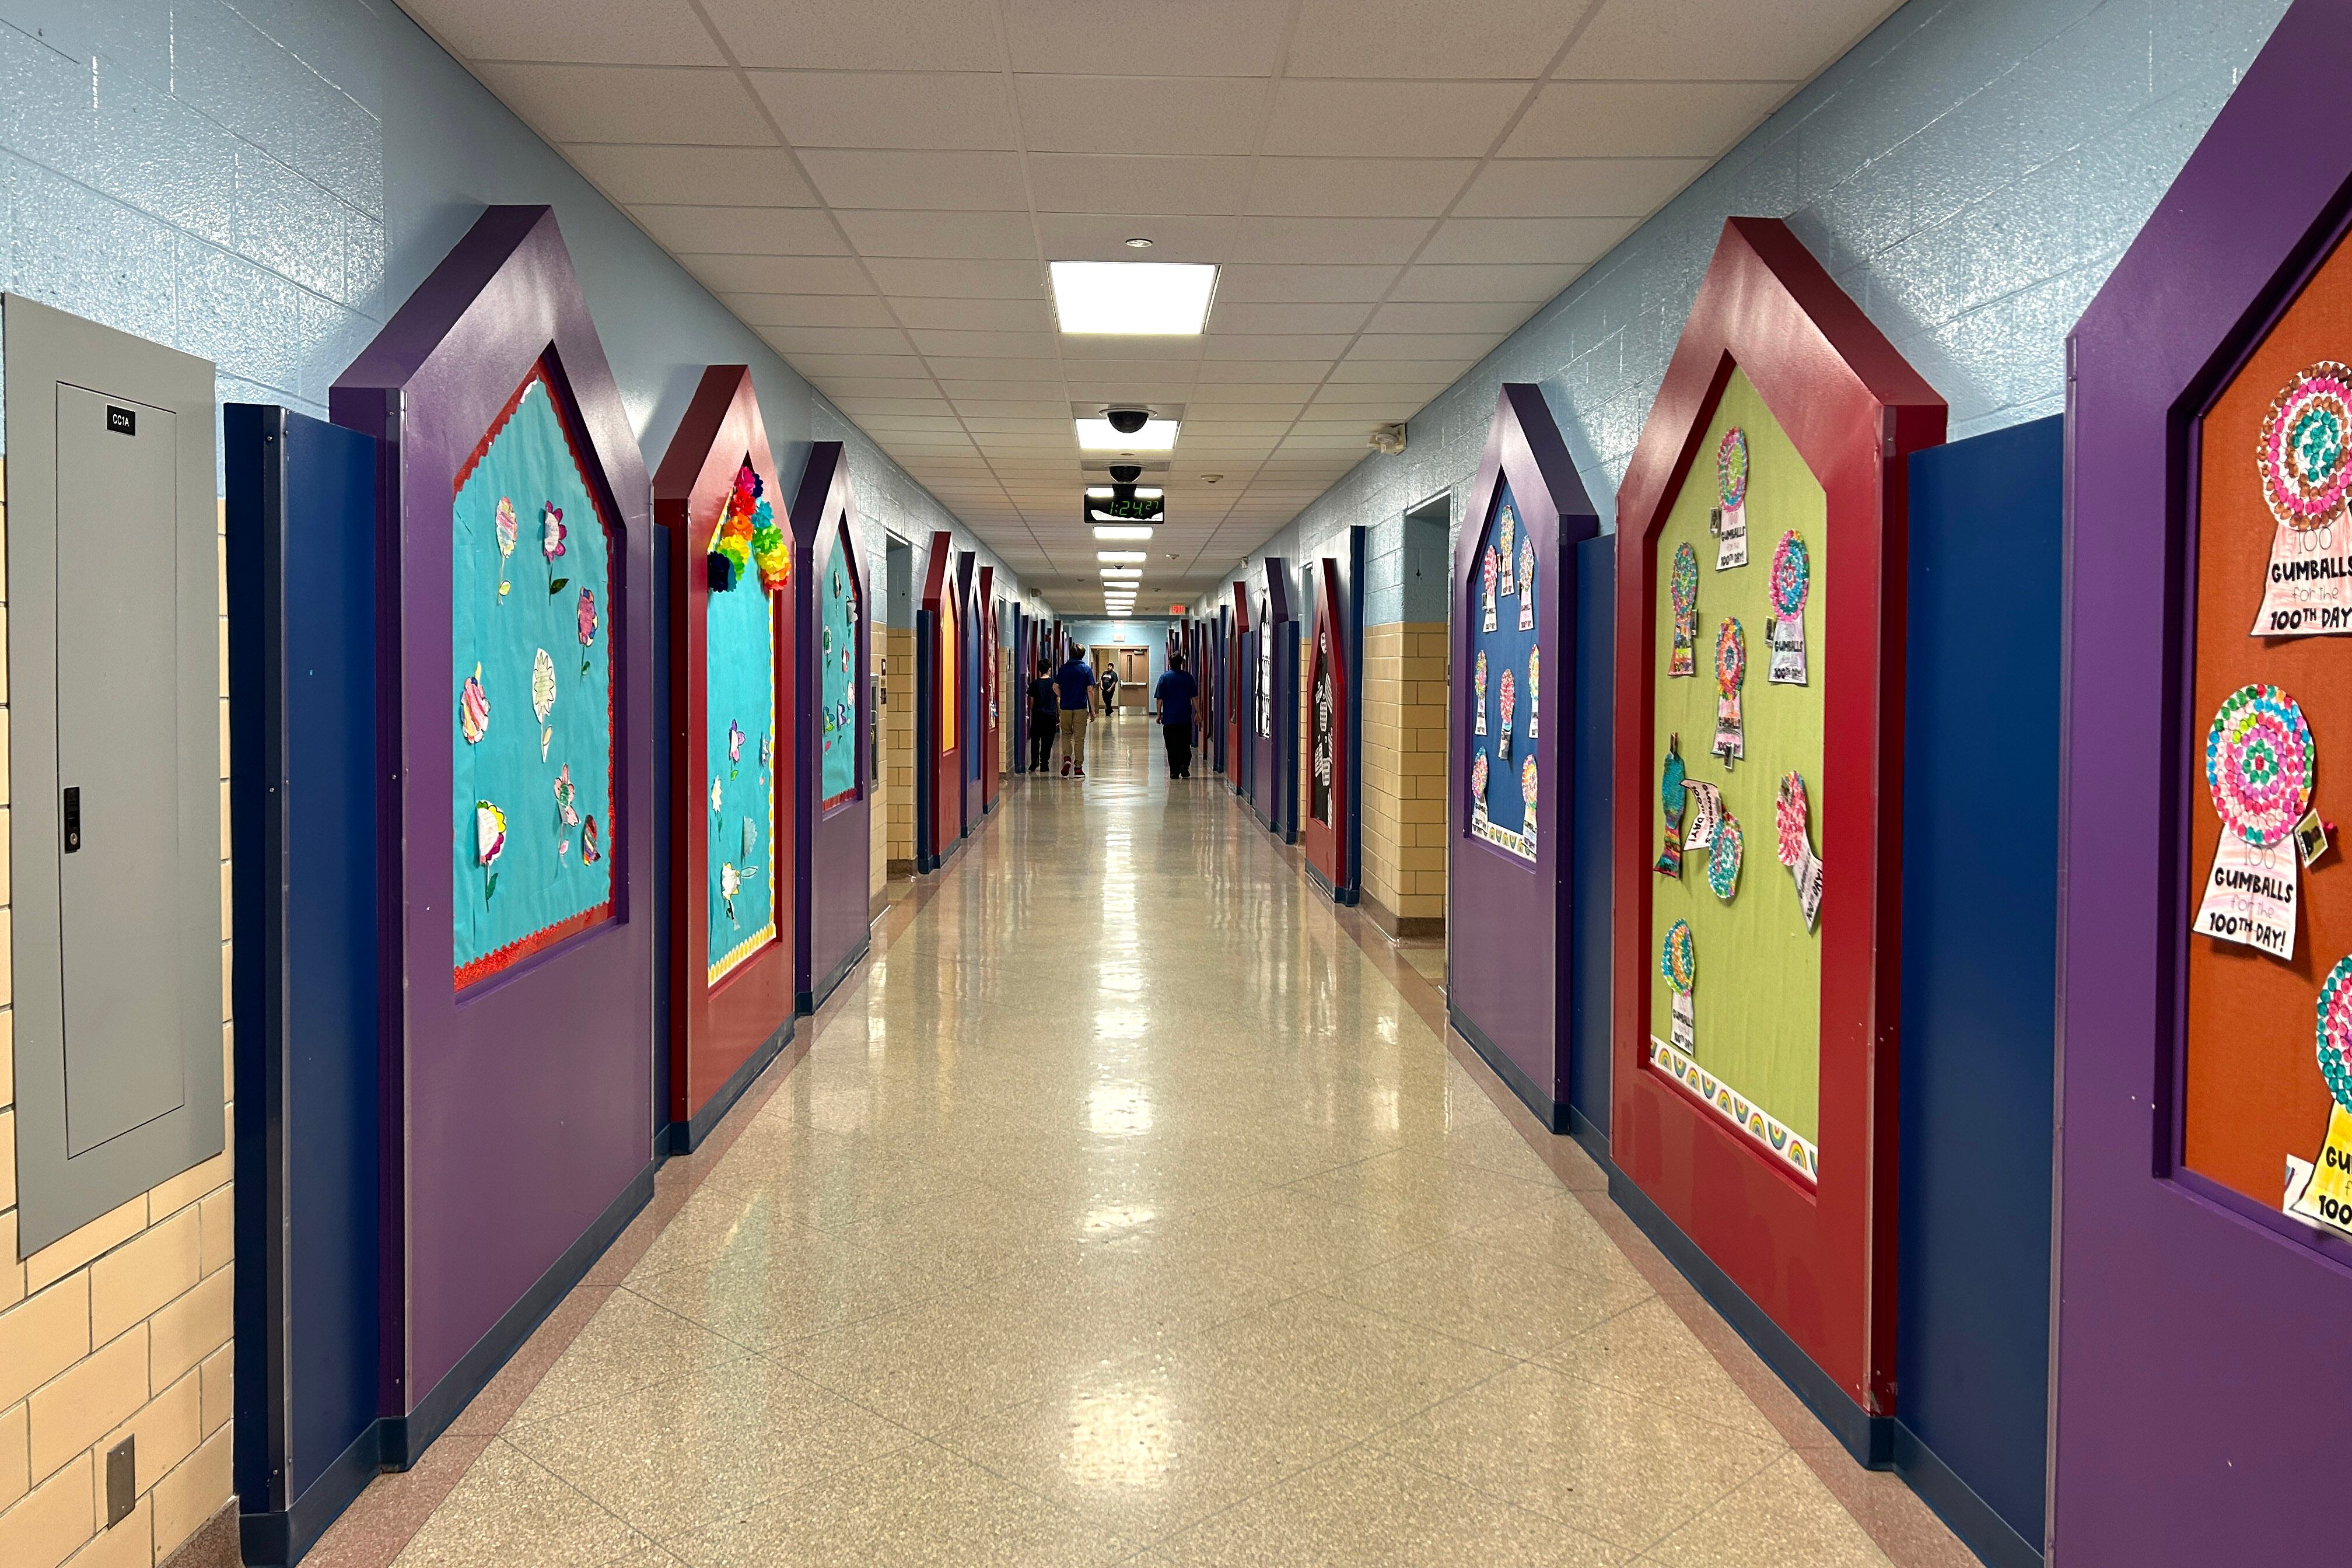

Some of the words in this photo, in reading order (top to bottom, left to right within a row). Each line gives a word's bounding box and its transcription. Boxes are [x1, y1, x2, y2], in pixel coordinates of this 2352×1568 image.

[113, 414, 130, 427] CC1A
[2292, 586, 2315, 602] for
[2319, 585, 2339, 601] the
[2270, 607, 2317, 631] 100TH
[1688, 817, 1705, 842] DAY!
[2244, 845, 2276, 869] 100
[2214, 867, 2294, 904] GUMBALLS
[2231, 893, 2254, 912] for
[2257, 901, 2275, 919] the
[2210, 912, 2253, 935] 100TH
[2255, 923, 2287, 953] DAY!
[2326, 1146, 2352, 1175] GU
